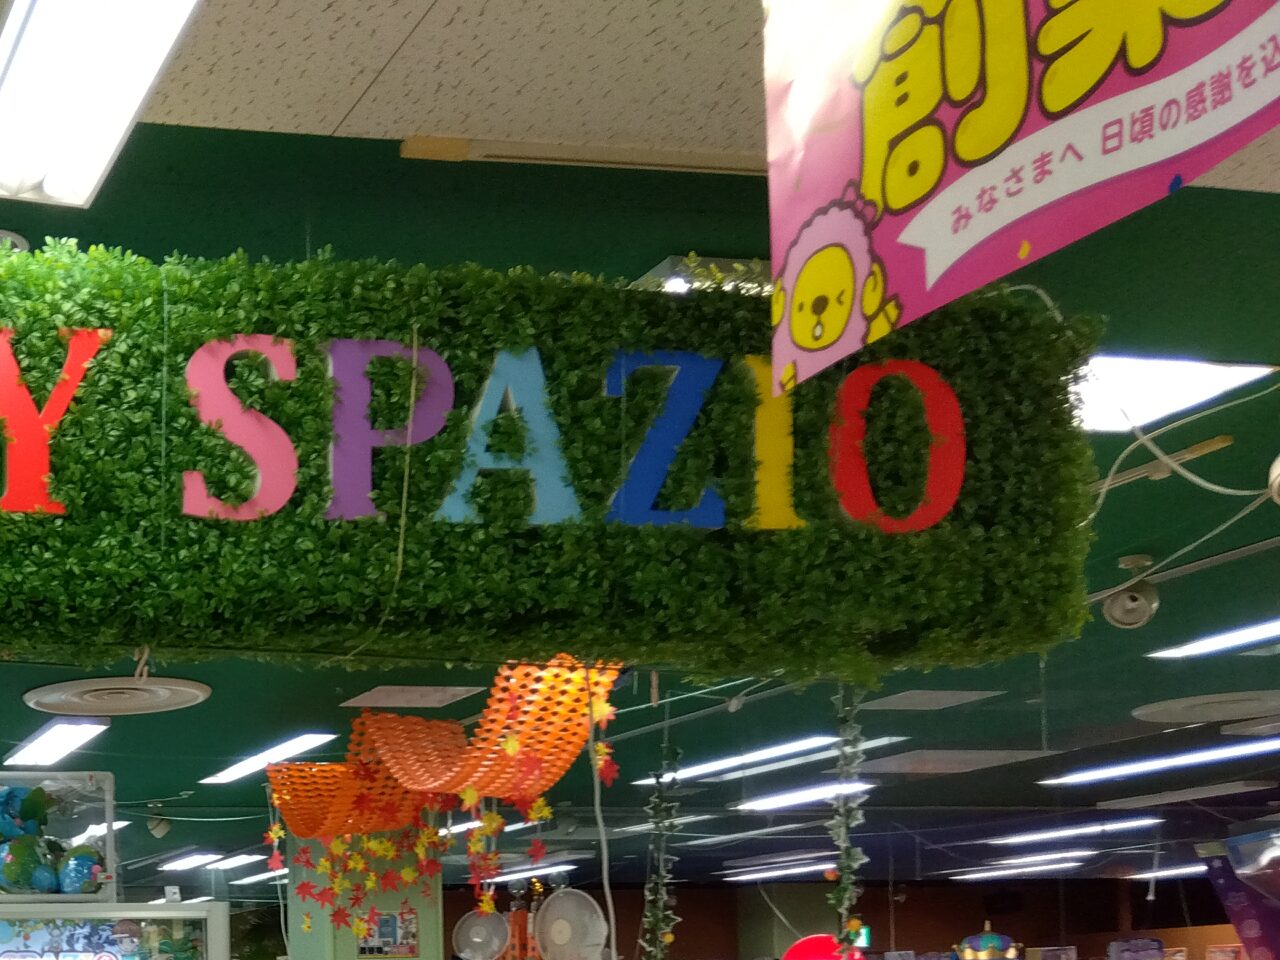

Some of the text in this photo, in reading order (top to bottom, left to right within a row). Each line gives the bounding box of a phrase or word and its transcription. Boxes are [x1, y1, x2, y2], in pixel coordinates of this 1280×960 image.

[950, 33, 1280, 236] みなさまへ 日頃の感謝を込
[182, 333, 968, 535] SPAZIO
